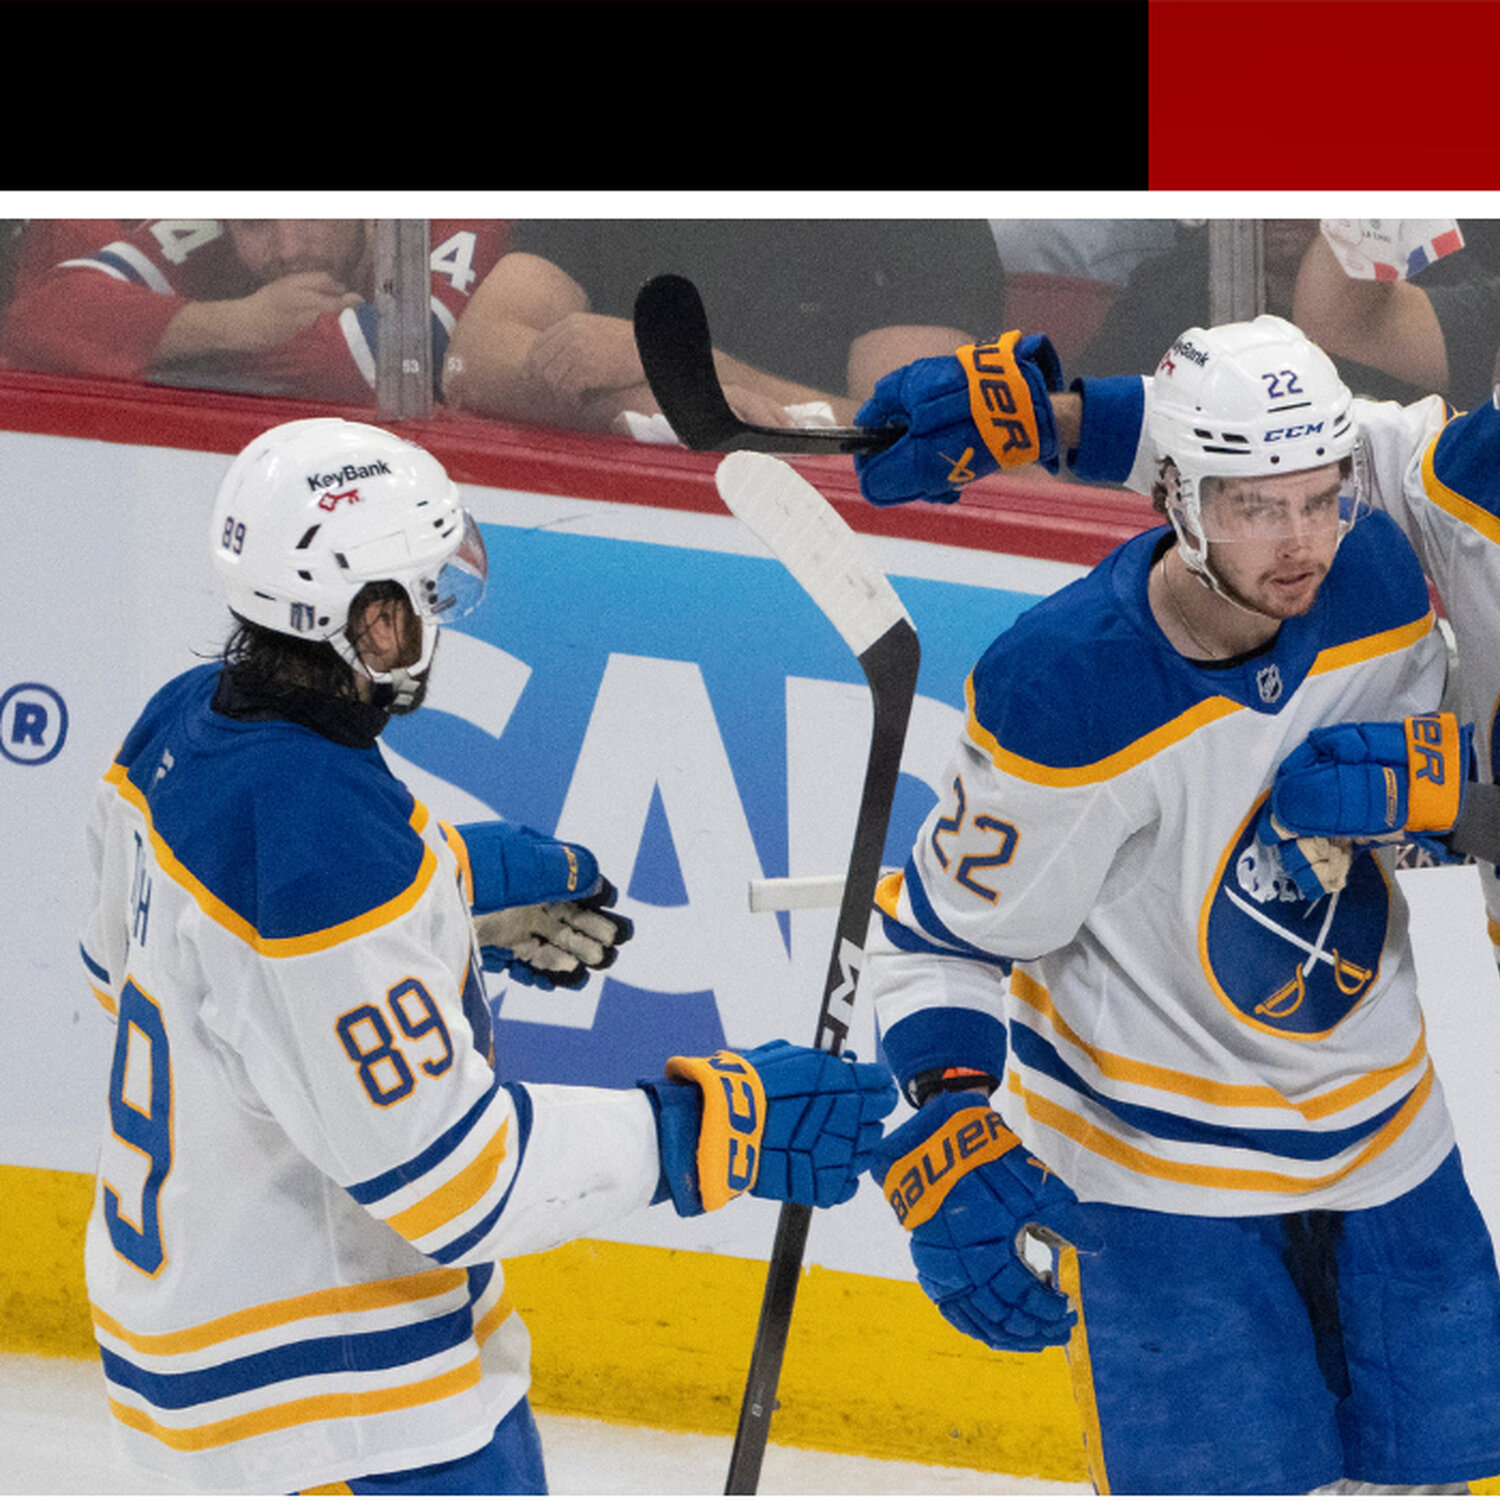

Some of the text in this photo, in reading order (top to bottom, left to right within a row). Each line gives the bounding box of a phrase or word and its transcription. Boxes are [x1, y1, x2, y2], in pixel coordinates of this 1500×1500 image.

[972, 337, 1032, 454] UER
[1262, 370, 1303, 399] 22
[1264, 422, 1325, 443] CCM
[307, 459, 392, 492] KeyBank
[222, 516, 246, 555] 89
[930, 774, 1021, 905] 22
[334, 975, 454, 1110] 89
